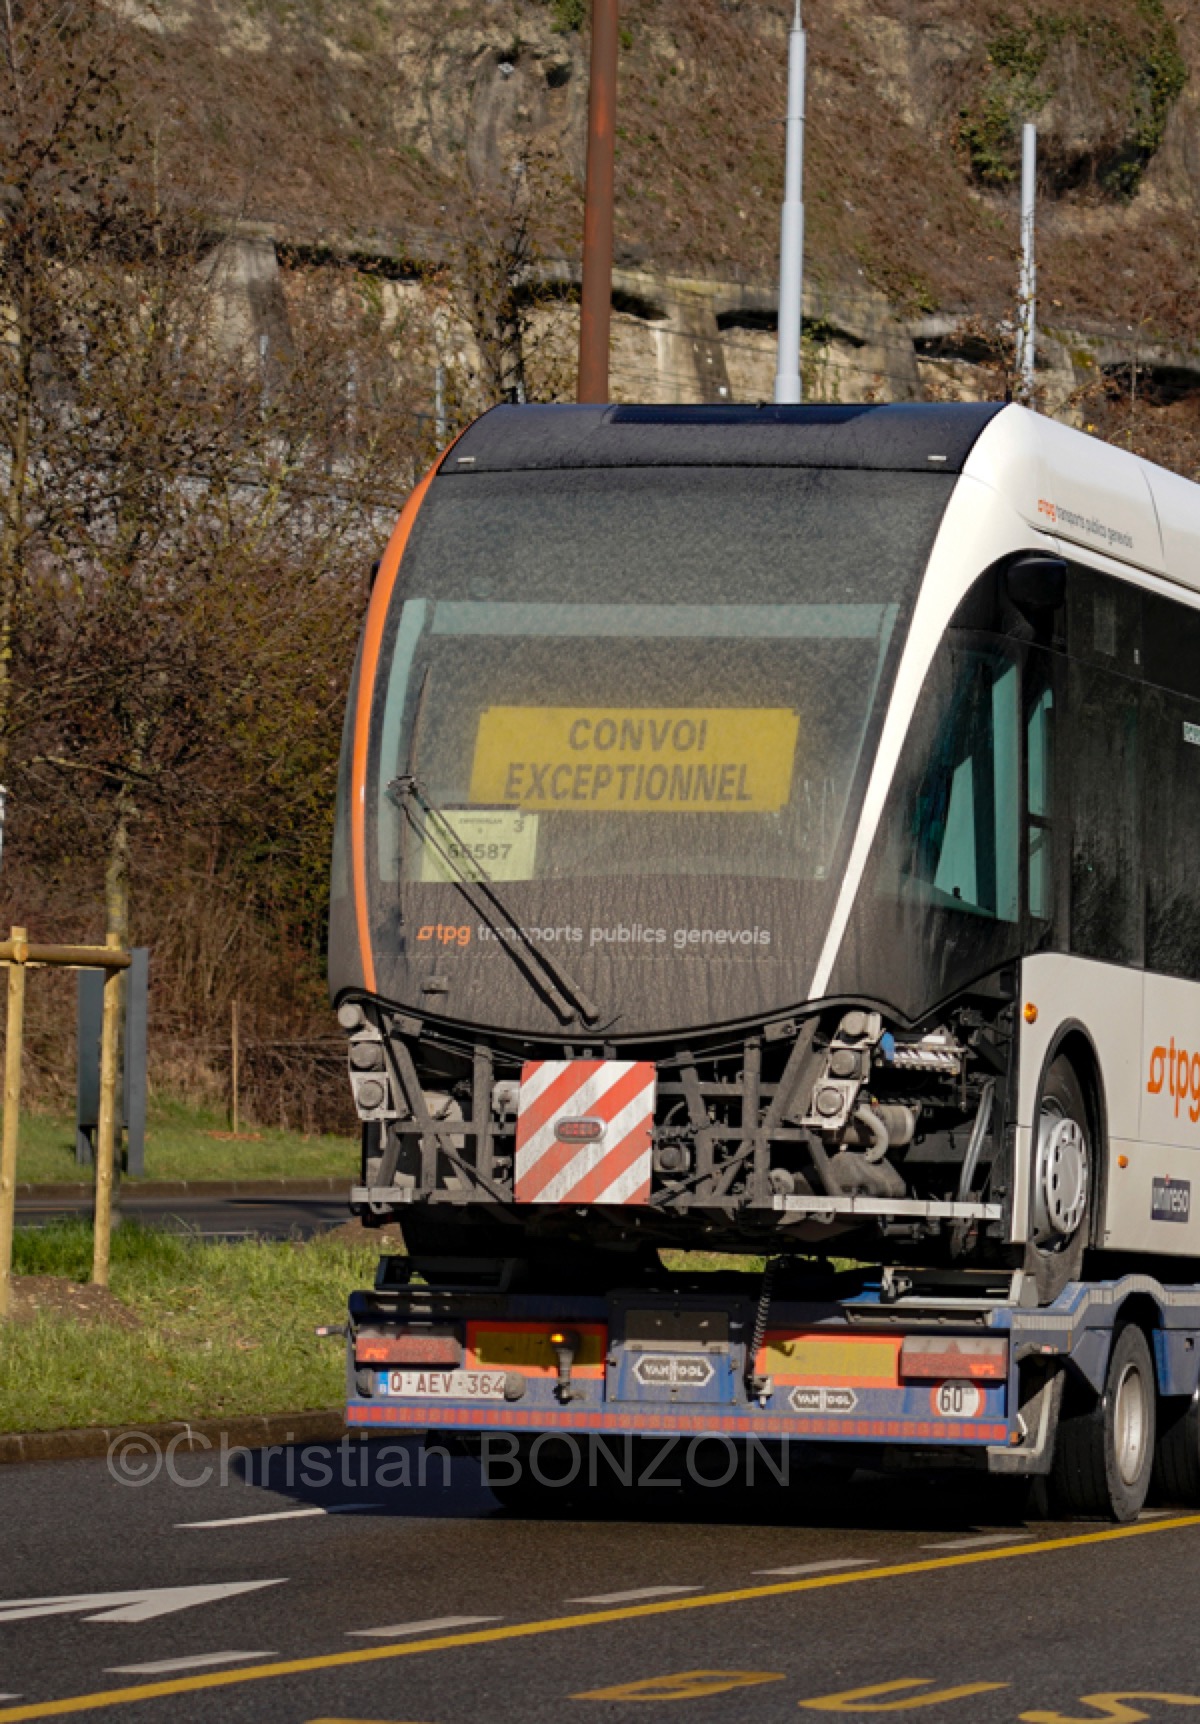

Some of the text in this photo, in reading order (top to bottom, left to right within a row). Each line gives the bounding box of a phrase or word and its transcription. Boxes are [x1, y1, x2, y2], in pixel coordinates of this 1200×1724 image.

[568, 717, 709, 751] CONVOI
[503, 762, 753, 801] EXCEPTIONNEL
[589, 923, 667, 947] publics
[673, 924, 771, 949] genevois
[941, 1386, 963, 1413] 60
